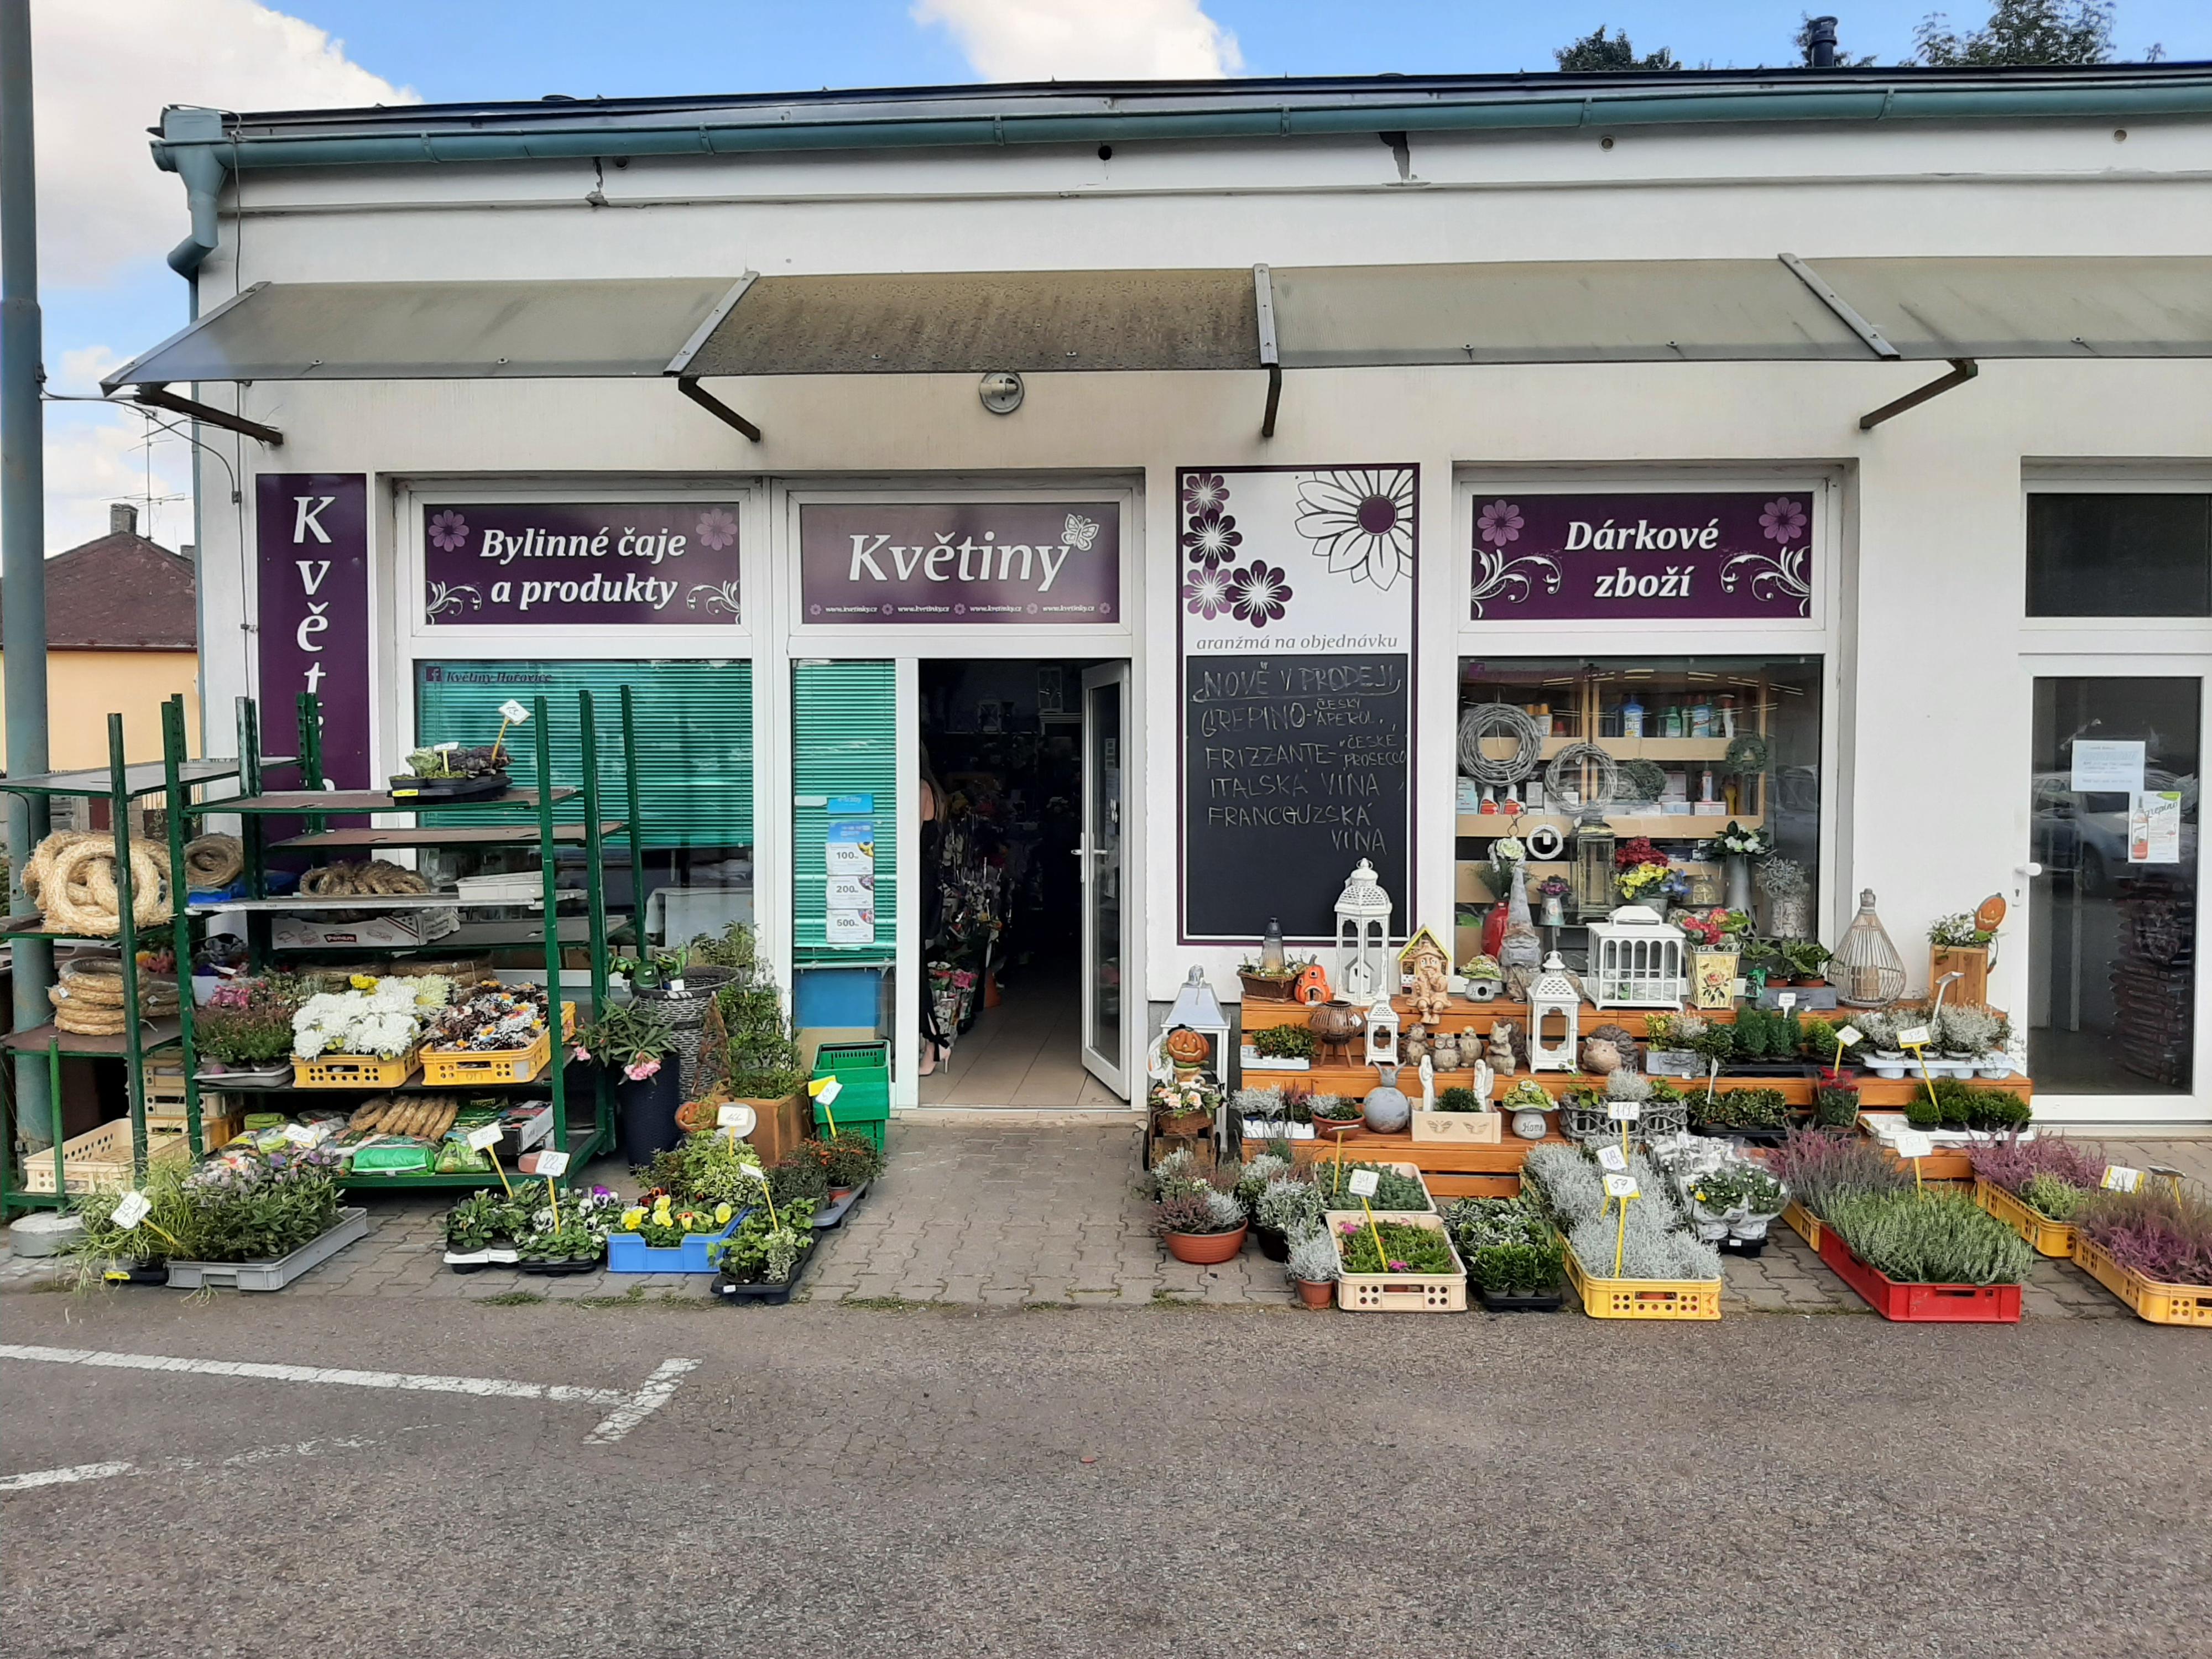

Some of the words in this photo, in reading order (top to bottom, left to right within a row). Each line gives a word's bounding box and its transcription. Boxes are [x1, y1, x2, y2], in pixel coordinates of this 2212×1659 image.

[479, 526, 609, 565] Bylinné
[617, 526, 687, 565] čaje
[1564, 518, 1719, 550] Dárkové
[848, 531, 1071, 592] Květiny
[491, 581, 512, 602] a
[519, 572, 678, 610] produkty
[1594, 566, 1696, 597] zboží
[1196, 635, 1270, 650] aranžmá
[1275, 638, 1295, 649] na
[1300, 633, 1398, 651] objednávku
[1280, 667, 1292, 691] V
[1298, 664, 1394, 691] PRODEJI
